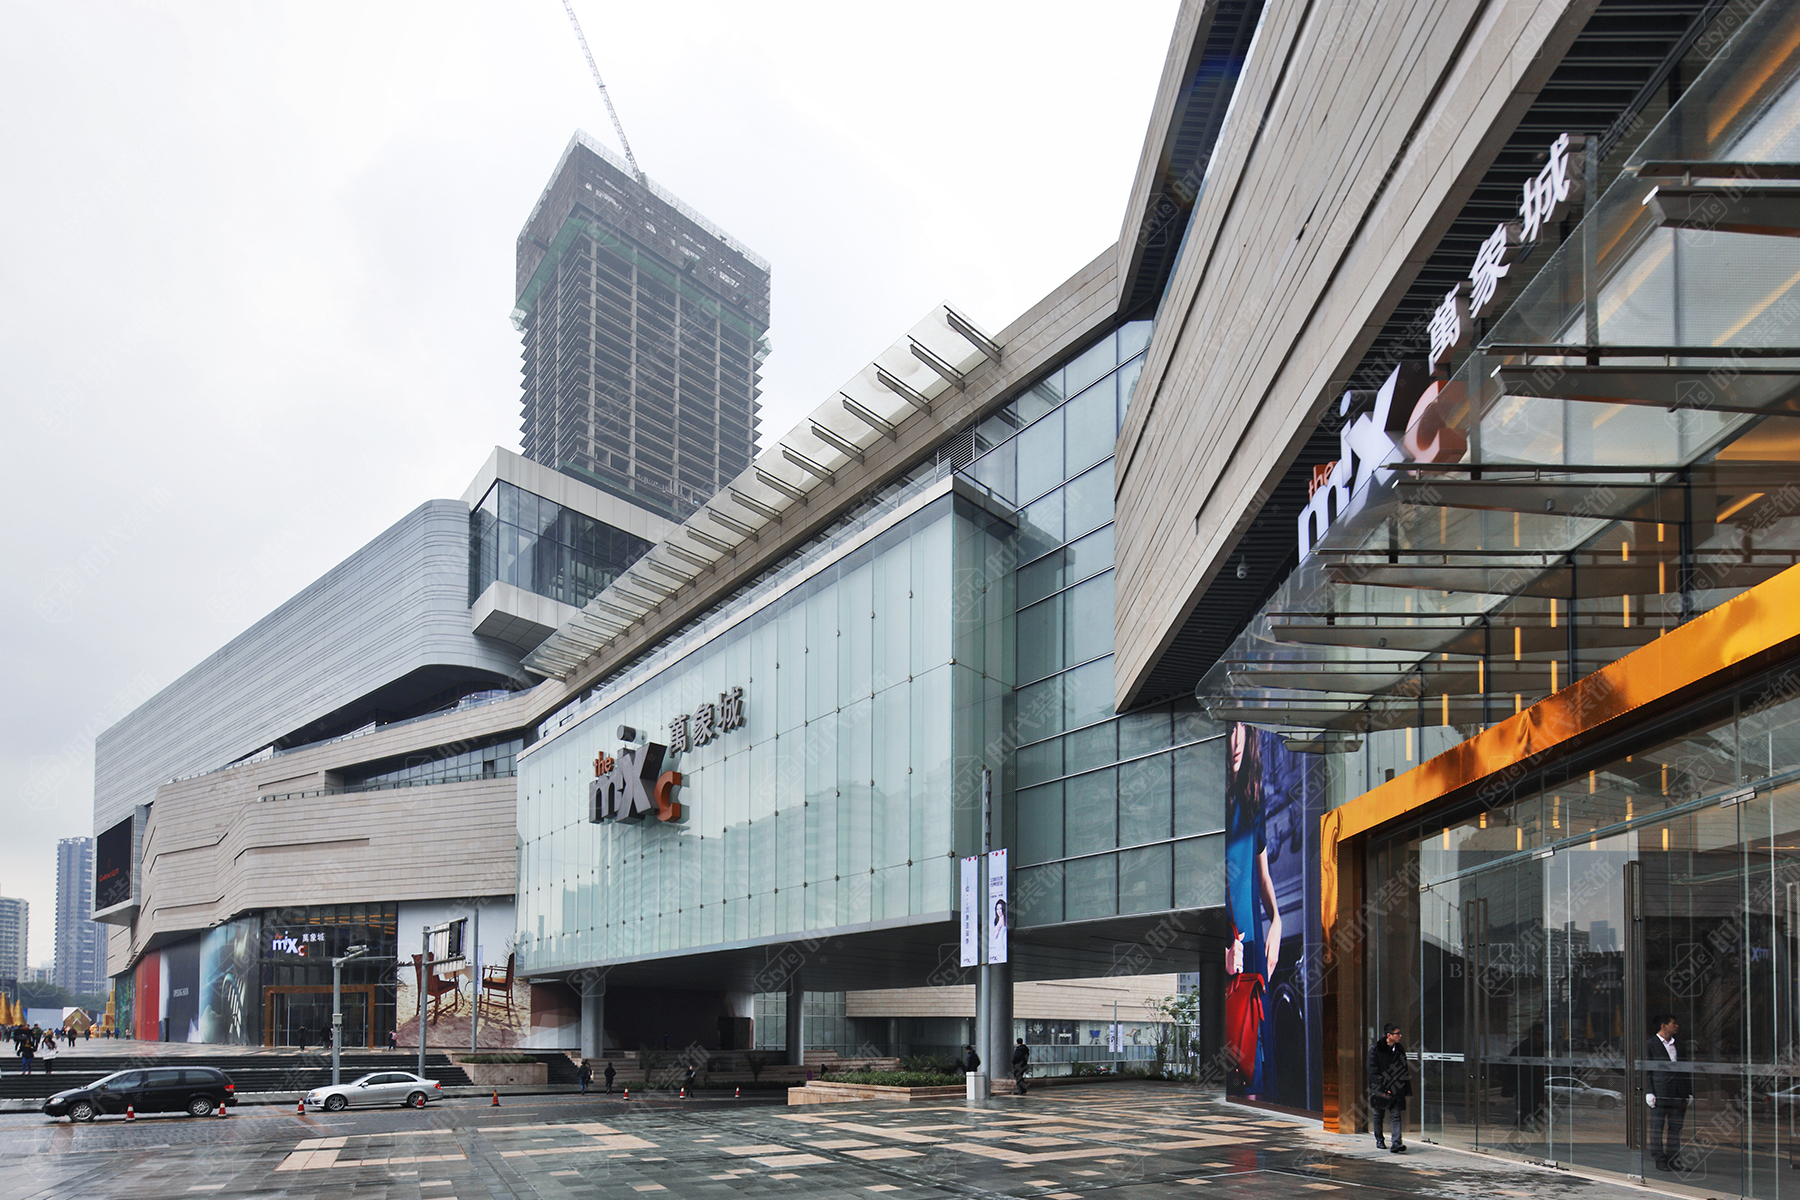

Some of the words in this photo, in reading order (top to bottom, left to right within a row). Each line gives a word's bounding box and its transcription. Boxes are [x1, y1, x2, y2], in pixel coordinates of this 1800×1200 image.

[1427, 133, 1575, 374] 萬象城
[1308, 461, 1338, 499] the
[668, 685, 746, 757] 萬象城
[593, 751, 614, 777] the
